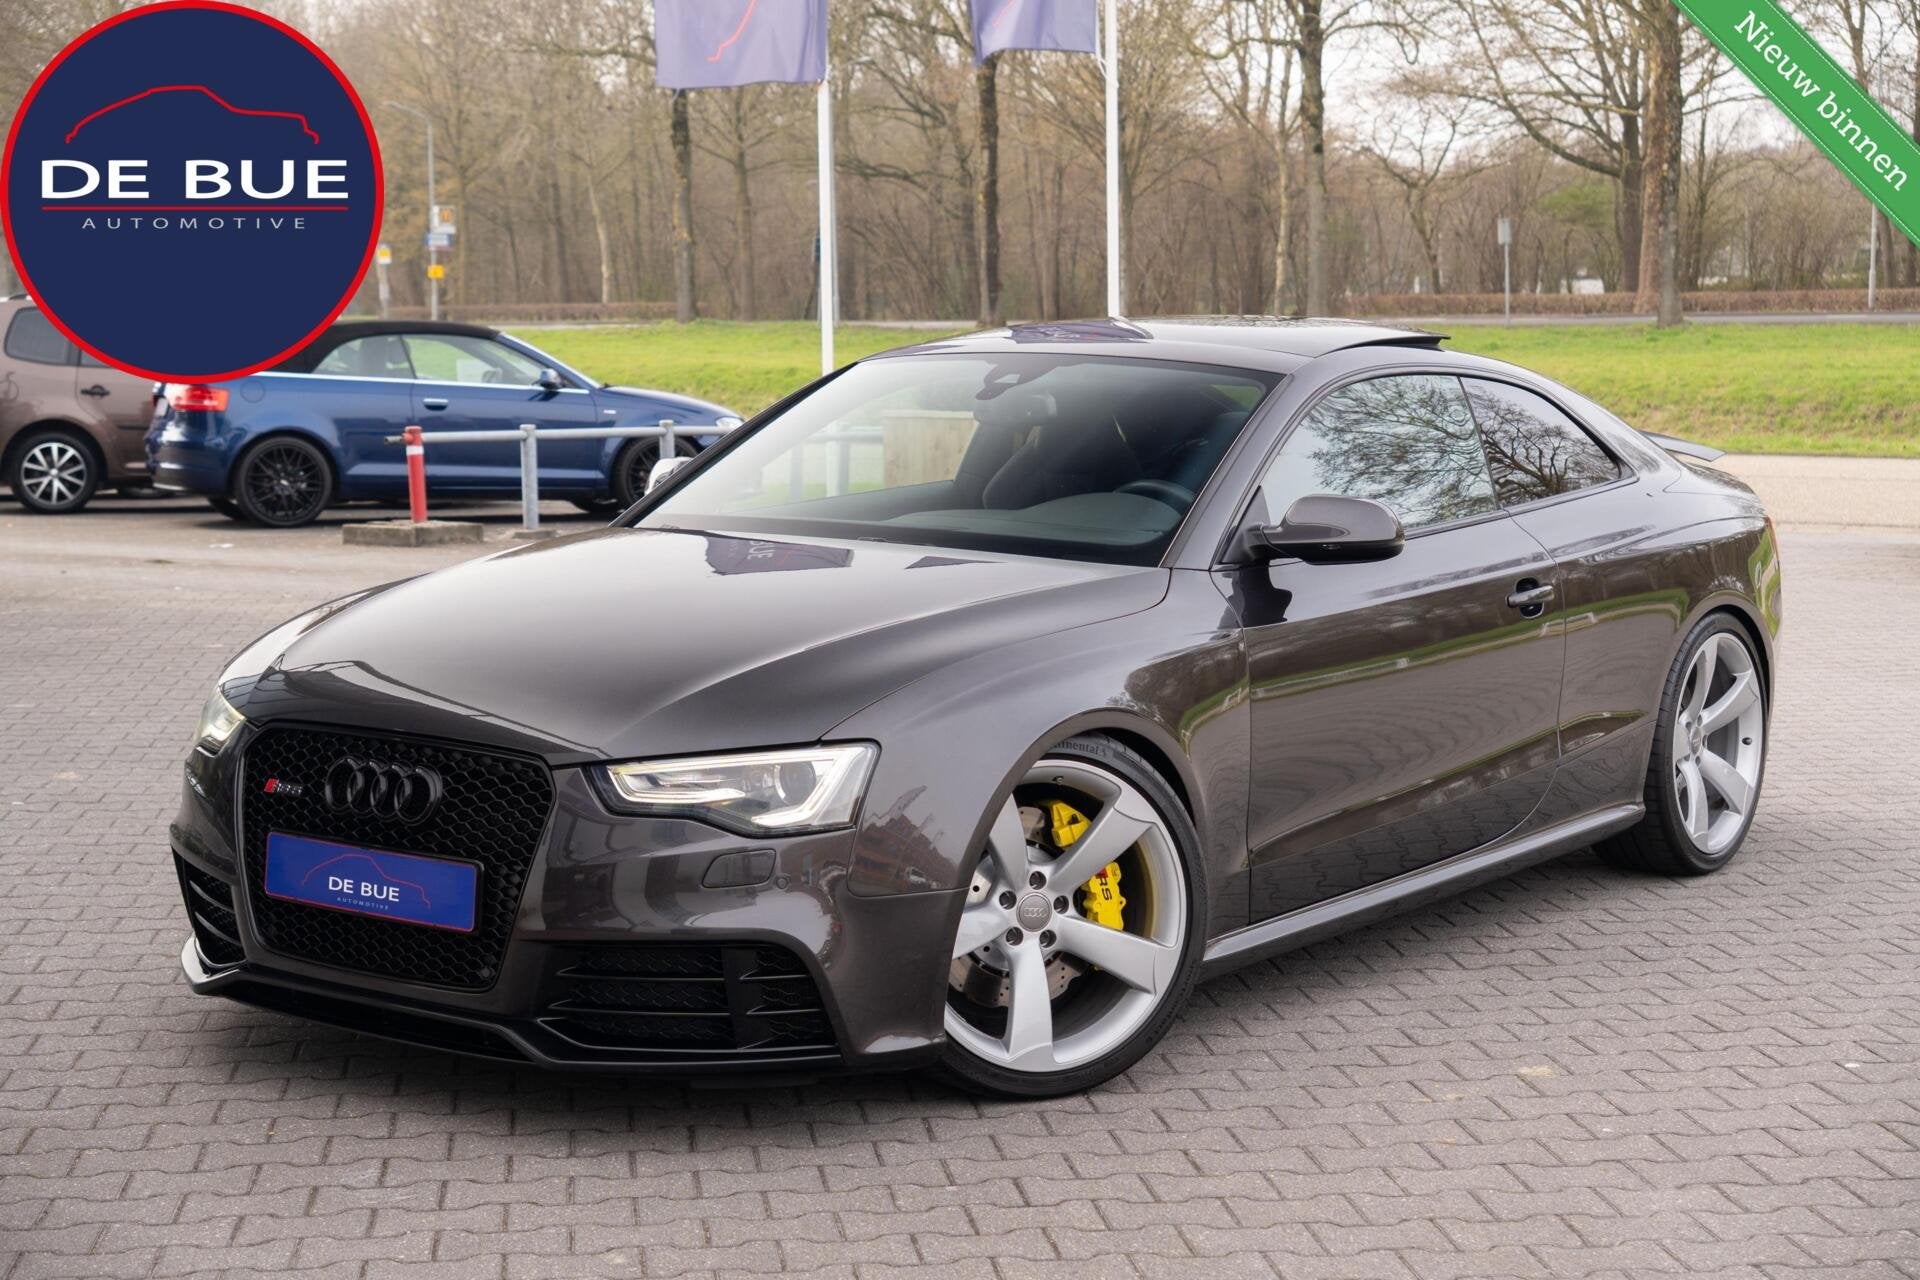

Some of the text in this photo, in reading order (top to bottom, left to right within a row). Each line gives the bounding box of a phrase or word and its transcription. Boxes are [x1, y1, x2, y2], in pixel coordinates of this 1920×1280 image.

[328, 876, 400, 902] DE BUE
[1097, 873, 1112, 901] RS
[336, 897, 389, 910] AUTOMOTIVE
